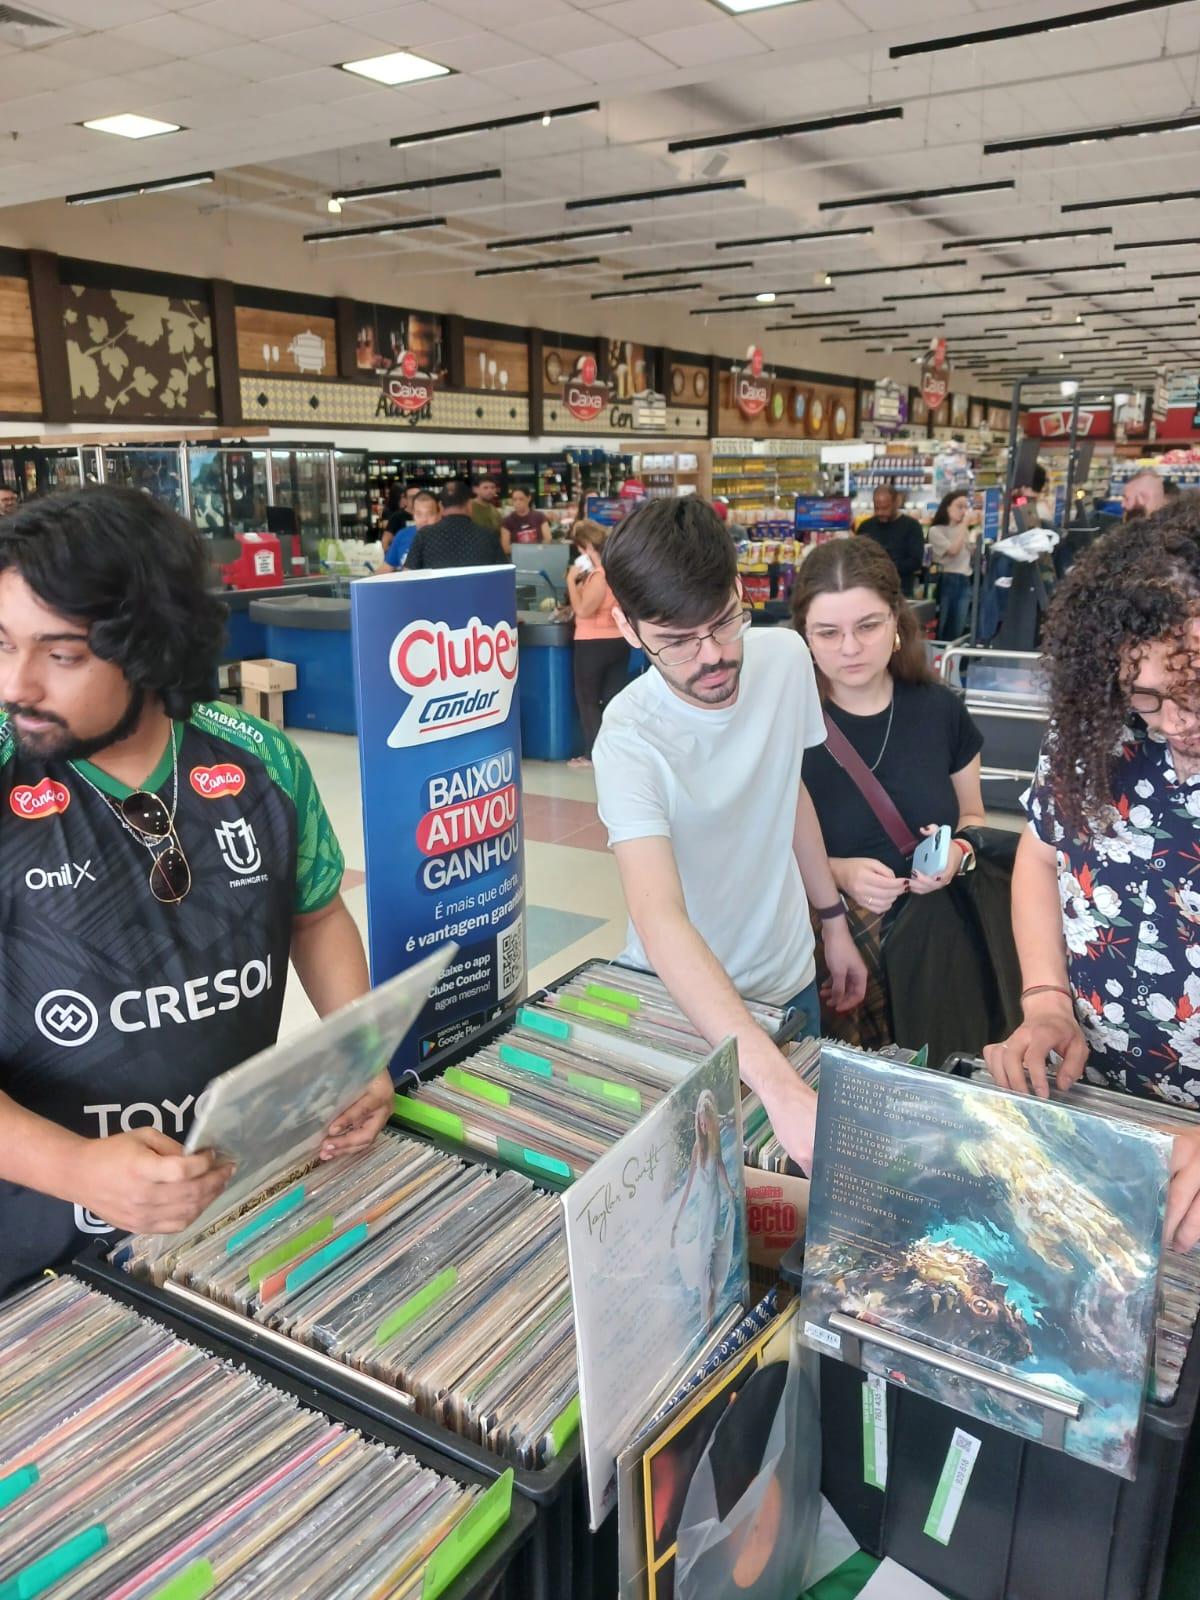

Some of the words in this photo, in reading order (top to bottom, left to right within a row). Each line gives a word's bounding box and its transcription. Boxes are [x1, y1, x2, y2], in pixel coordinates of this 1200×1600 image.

[389, 381, 427, 398] Caixa
[568, 389, 602, 408] Caixa
[740, 380, 767, 400] Caixa
[397, 626, 518, 687] Clube
[418, 689, 499, 724] Condor
[198, 703, 264, 744] EMBRAED
[429, 751, 513, 809] BAIXOU
[426, 787, 516, 851] ATIVOU
[423, 823, 519, 890] GANHOU
[25, 859, 97, 890] OnilX
[435, 901, 444, 920] É
[446, 896, 475, 916] mais
[477, 888, 497, 907] que
[405, 936, 416, 952] é
[418, 913, 490, 947] vantagem
[464, 961, 472, 969] o
[472, 954, 491, 967] app
[428, 981, 455, 999] Clube
[456, 968, 491, 987] Condor
[434, 993, 457, 1011] agora
[458, 981, 491, 1001] mesmo!
[438, 1030, 465, 1048] Google
[576, 1182, 621, 1243] Taylor
[622, 1140, 668, 1199] Swift
[831, 1194, 847, 1203] OUT
[849, 1199, 859, 1207] OF
[860, 1177, 874, 1188] THE
[876, 1184, 925, 1204] MOONLIGHT
